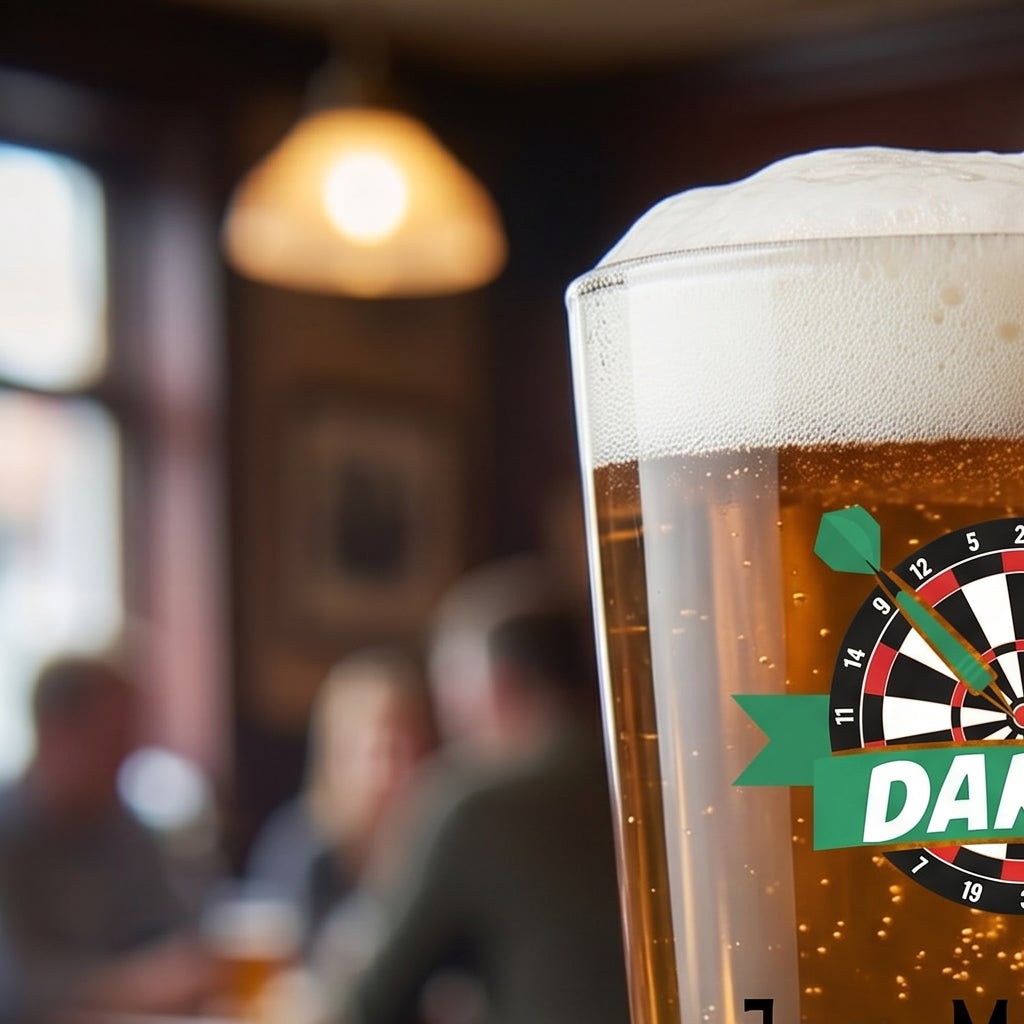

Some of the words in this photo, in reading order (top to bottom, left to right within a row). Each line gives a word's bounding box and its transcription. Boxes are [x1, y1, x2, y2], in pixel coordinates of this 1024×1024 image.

[965, 531, 980, 552] 5
[908, 556, 934, 582] 12
[871, 596, 892, 616] 9
[842, 646, 867, 669] 14
[833, 707, 855, 727] 11
[910, 854, 930, 875] 7
[960, 879, 984, 904] 19
